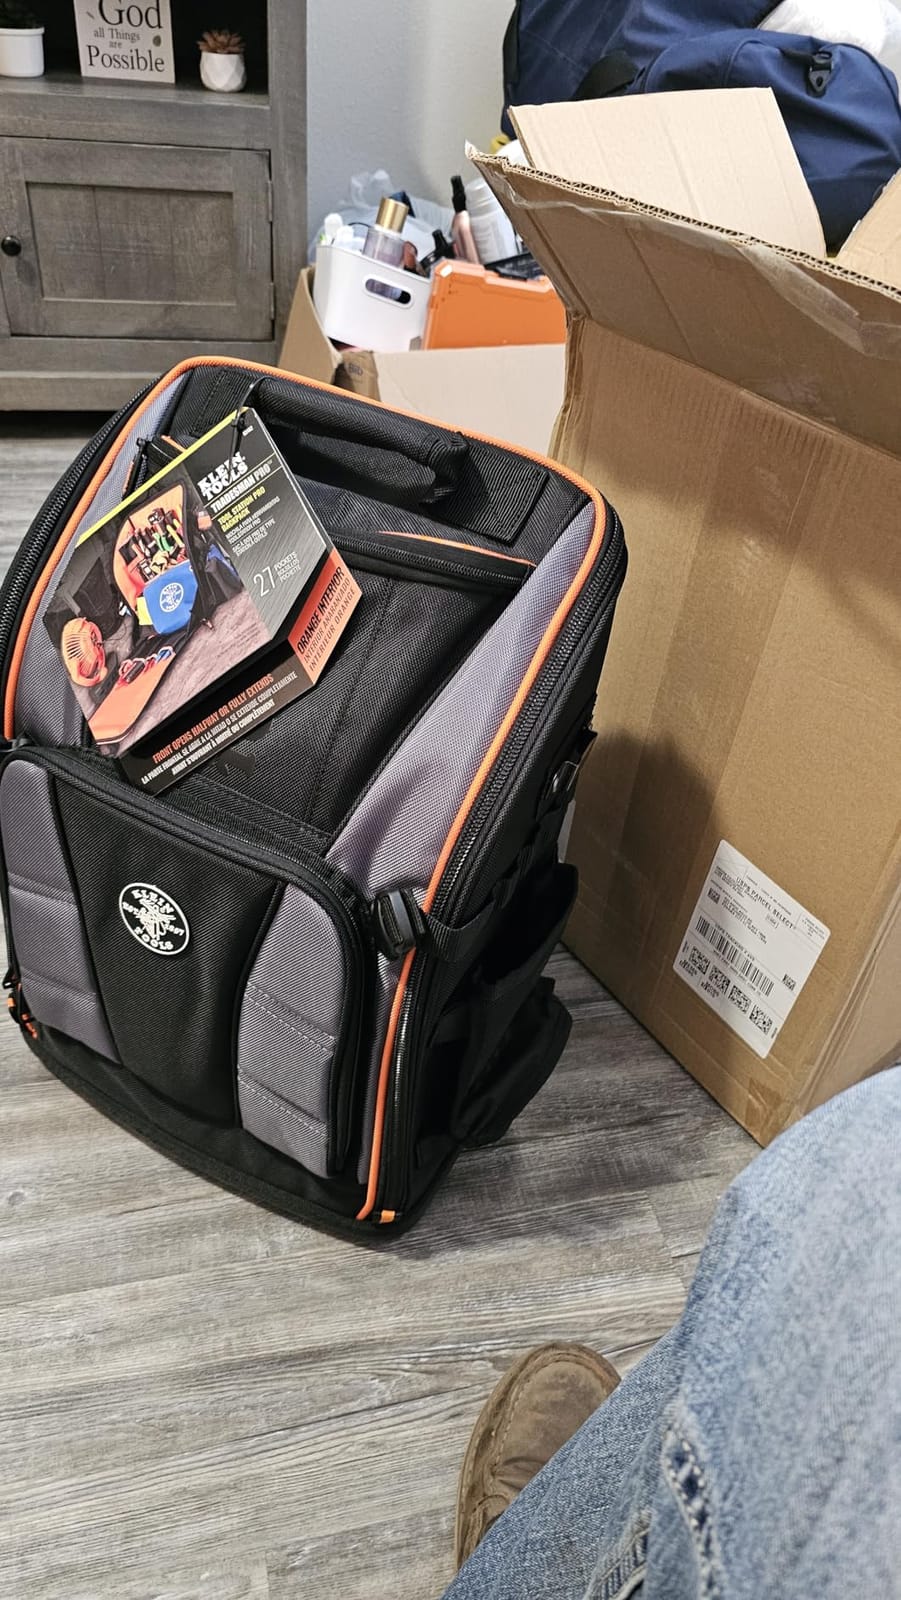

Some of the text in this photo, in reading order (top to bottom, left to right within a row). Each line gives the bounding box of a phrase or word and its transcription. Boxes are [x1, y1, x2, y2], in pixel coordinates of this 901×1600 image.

[98, 0, 163, 29] God
[94, 28, 140, 43] all Things
[109, 41, 122, 49] are
[86, 45, 165, 72] Possible
[211, 475, 256, 513] TRADESMAN
[253, 486, 266, 499] PRO
[221, 507, 250, 532] BACKPACK
[274, 551, 297, 571] POCKETS
[253, 566, 275, 597] 27
[297, 566, 344, 654] ORANGE INTERIOR
[335, 586, 356, 625] ORANGE
[304, 626, 326, 664] INTERIOR
[153, 673, 275, 764] FRONT OPENS HALFWAY OR FULLY EXTENDS
[131, 889, 174, 914] KLEIN
[751, 891, 772, 910] PARCEL
[134, 926, 174, 950] TOOLS
